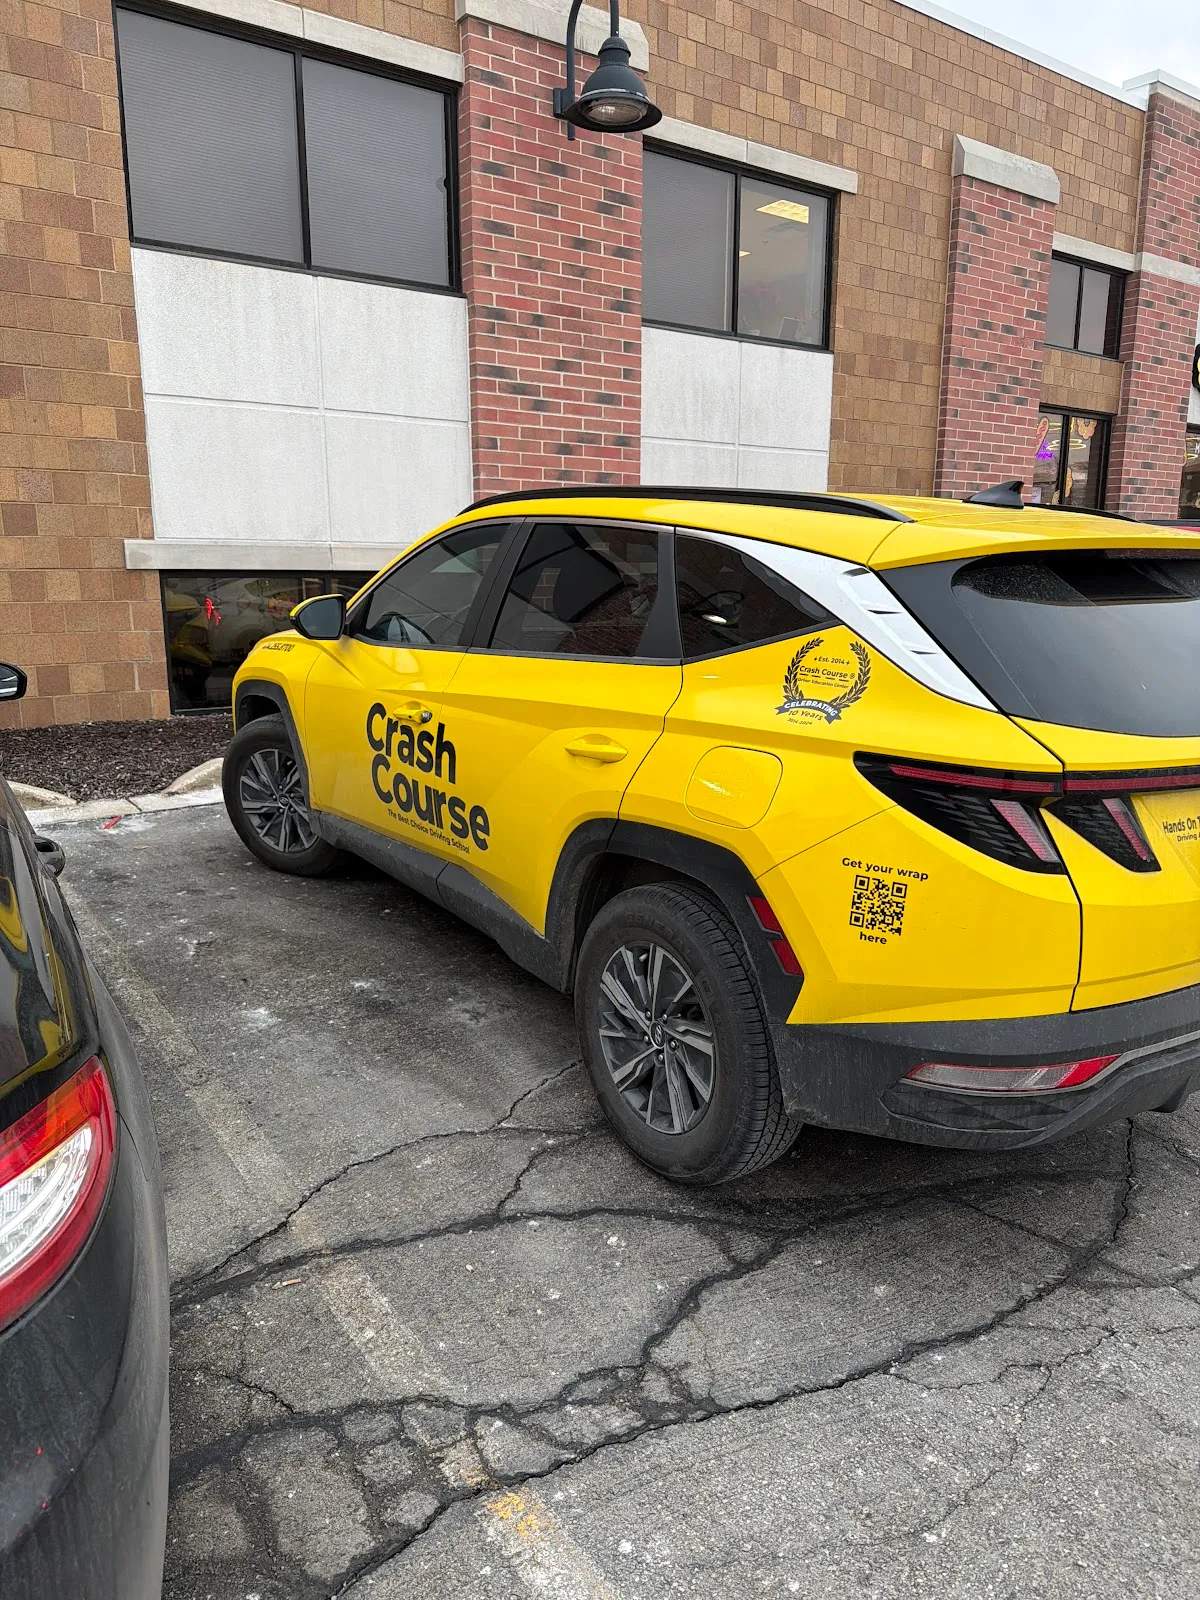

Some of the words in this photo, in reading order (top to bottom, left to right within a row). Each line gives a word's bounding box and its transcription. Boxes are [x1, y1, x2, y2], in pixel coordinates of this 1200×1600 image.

[799, 665, 820, 674] Crash
[822, 668, 848, 678] Course
[784, 700, 838, 717] CELEBRATING
[800, 710, 824, 721] Years
[366, 702, 457, 785] Crash
[371, 753, 491, 851] Course
[1162, 818, 1186, 834] Hands
[1186, 817, 1198, 830] On
[1176, 832, 1198, 842] Driving
[842, 857, 863, 868] Get
[865, 862, 894, 874] your
[897, 868, 929, 882] wrap
[860, 932, 888, 944] here
